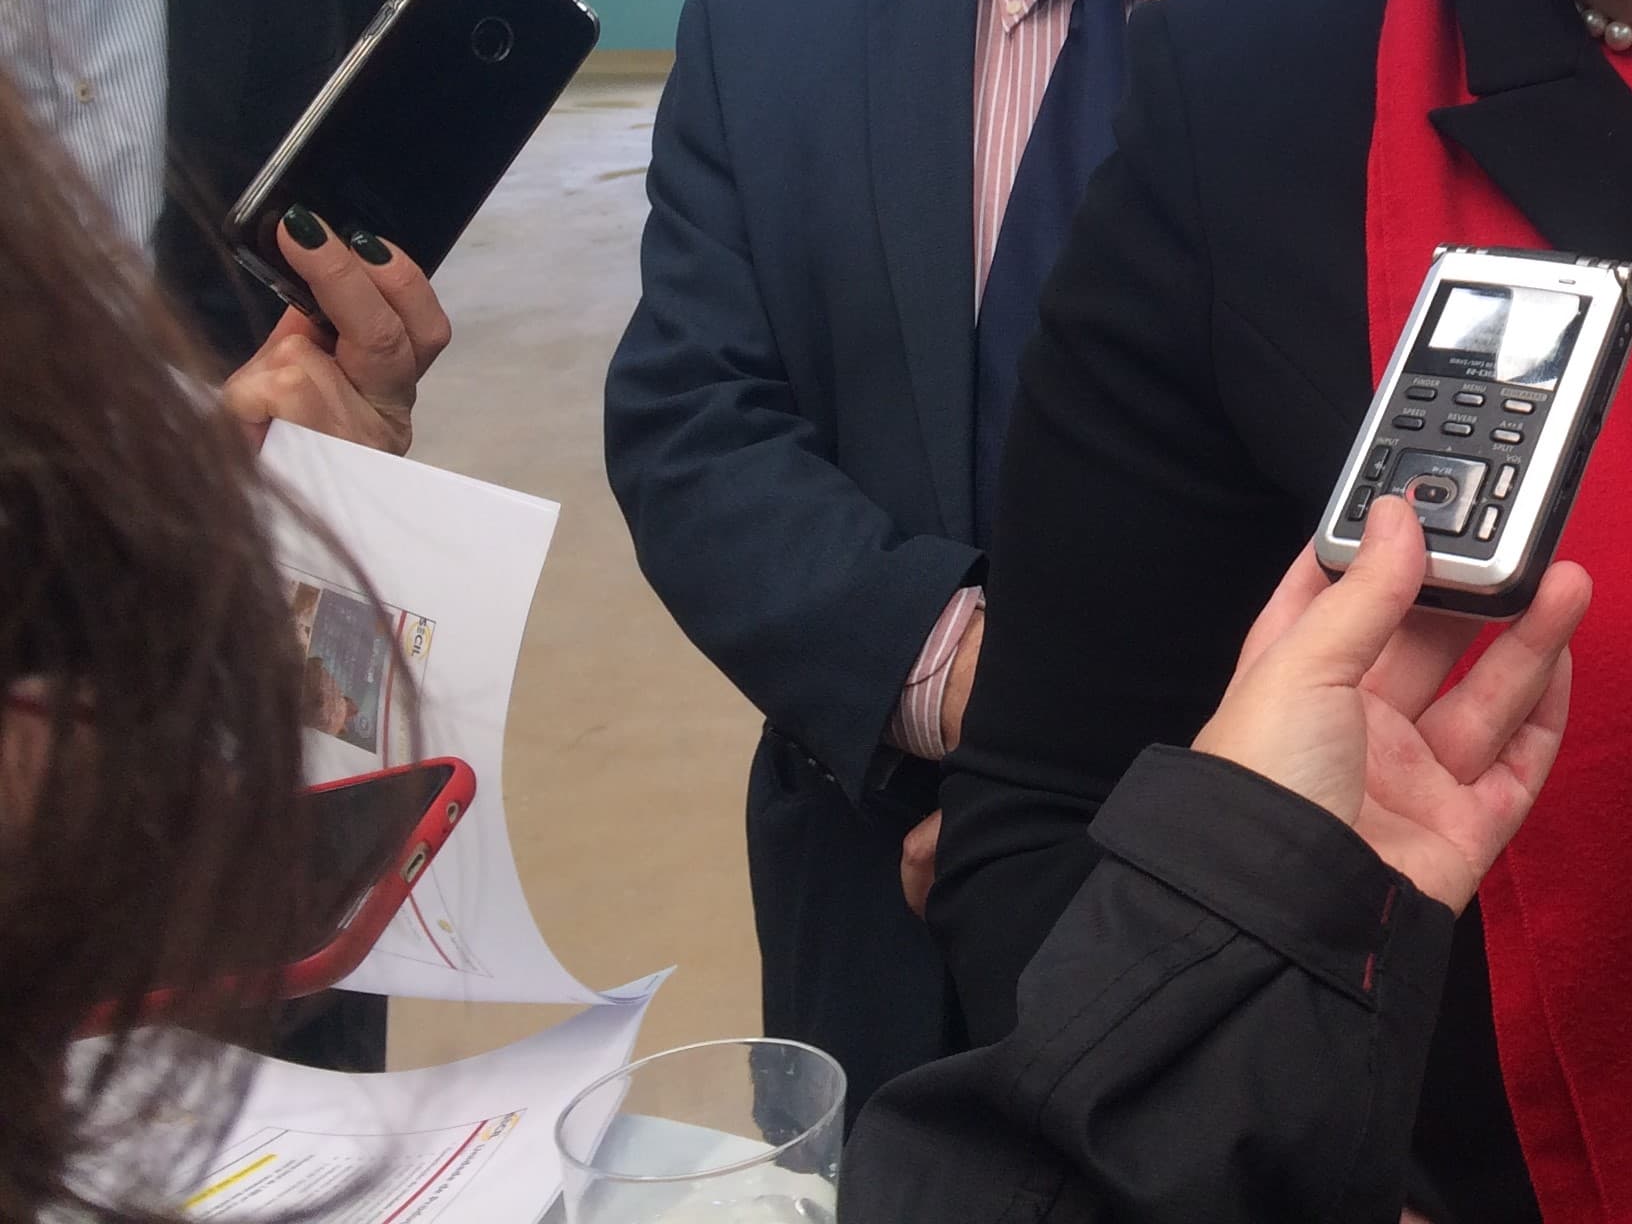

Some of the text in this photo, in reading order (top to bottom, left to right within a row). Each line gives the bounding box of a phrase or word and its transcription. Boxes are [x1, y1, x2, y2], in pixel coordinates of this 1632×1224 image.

[1413, 377, 1441, 387] FINDER
[1462, 383, 1487, 392] MENU
[1402, 407, 1427, 417] SPEED
[410, 616, 428, 657] SECIL
